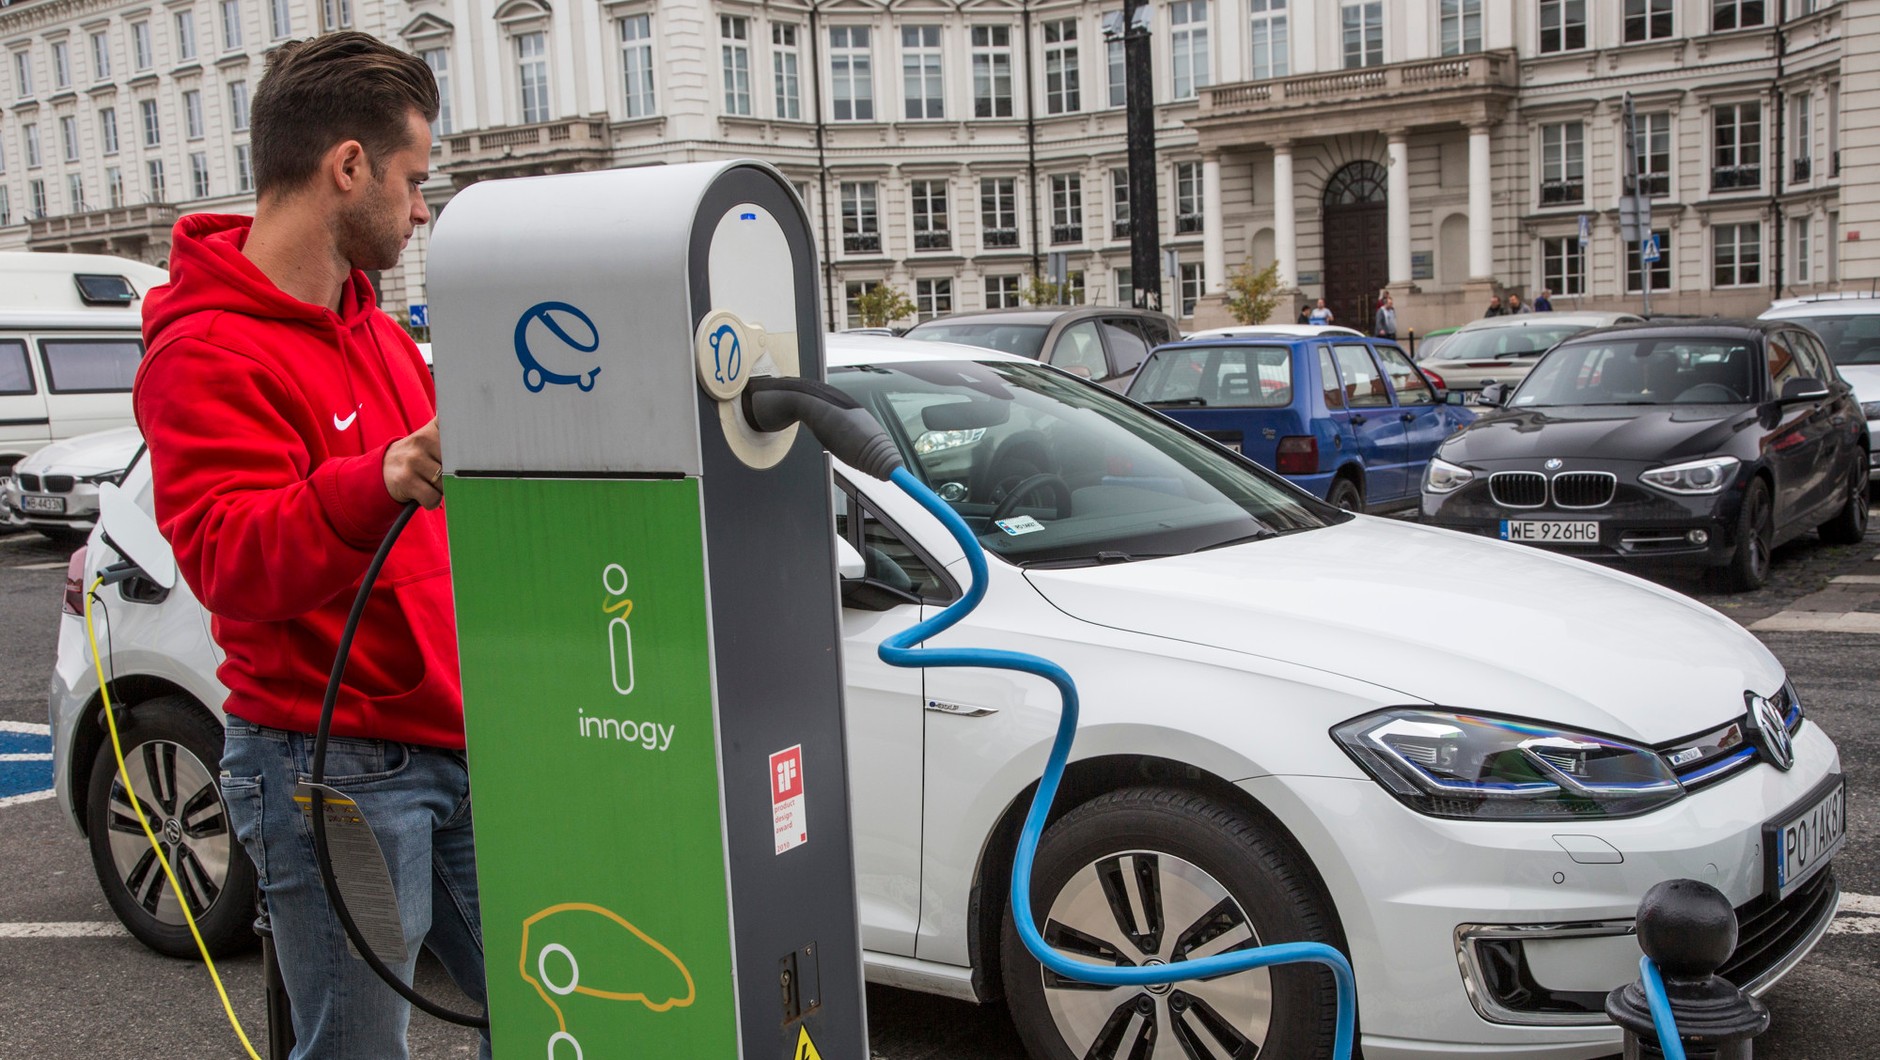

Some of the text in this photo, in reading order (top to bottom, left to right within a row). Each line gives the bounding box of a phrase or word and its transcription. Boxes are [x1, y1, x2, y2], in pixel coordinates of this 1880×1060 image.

[1511, 522, 1596, 540] WE 926HG
[578, 707, 675, 752] innogy
[774, 800, 796, 814] product
[775, 812, 793, 824] design
[776, 822, 793, 834] award
[1787, 820, 1807, 878] PO
